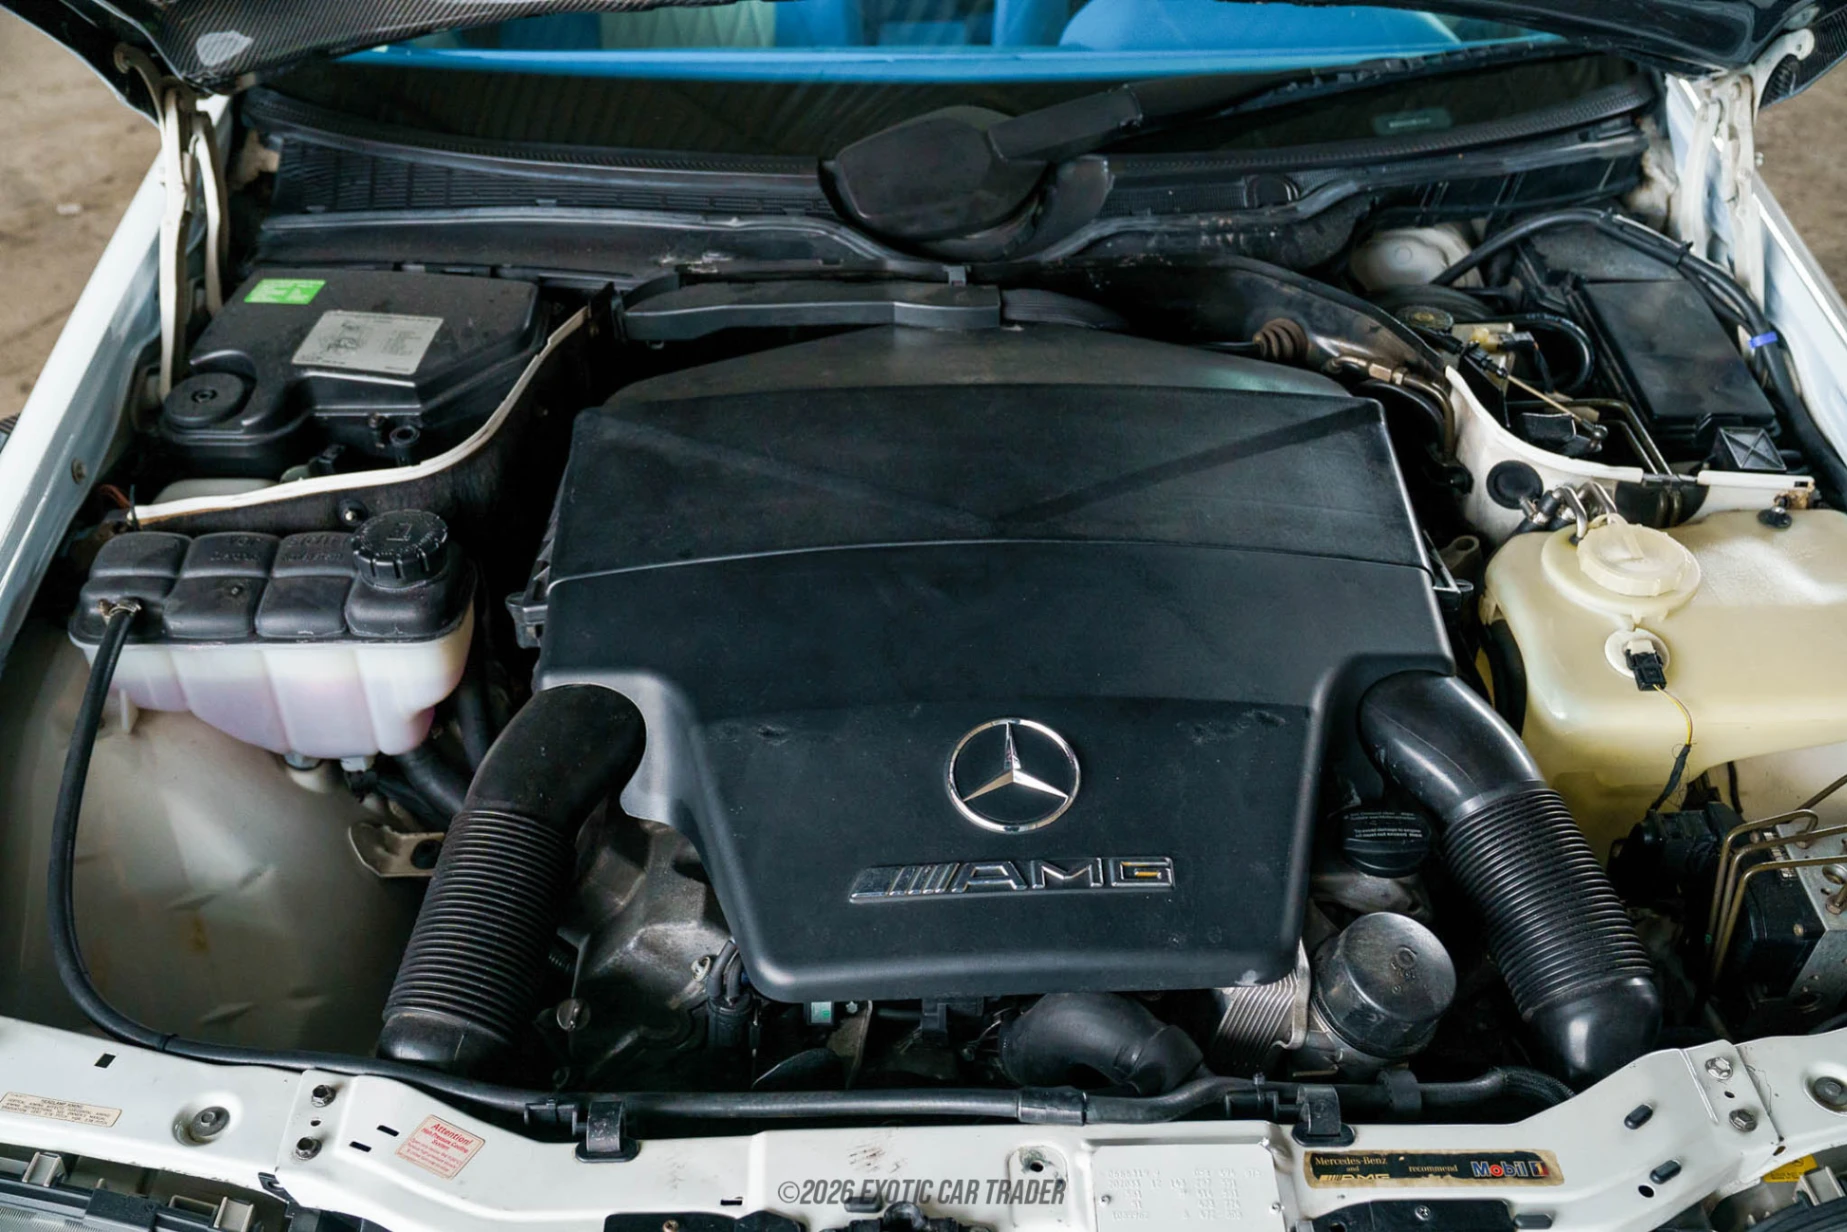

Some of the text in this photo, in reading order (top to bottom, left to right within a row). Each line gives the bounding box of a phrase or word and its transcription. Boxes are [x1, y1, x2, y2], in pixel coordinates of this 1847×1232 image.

[951, 857, 1175, 892] AMG
[431, 1123, 473, 1145] Attention!
[1315, 1156, 1388, 1166] Mercedes-Benz
[1409, 1164, 1458, 1173] recommend
[1470, 1160, 1529, 1177] Mobil
